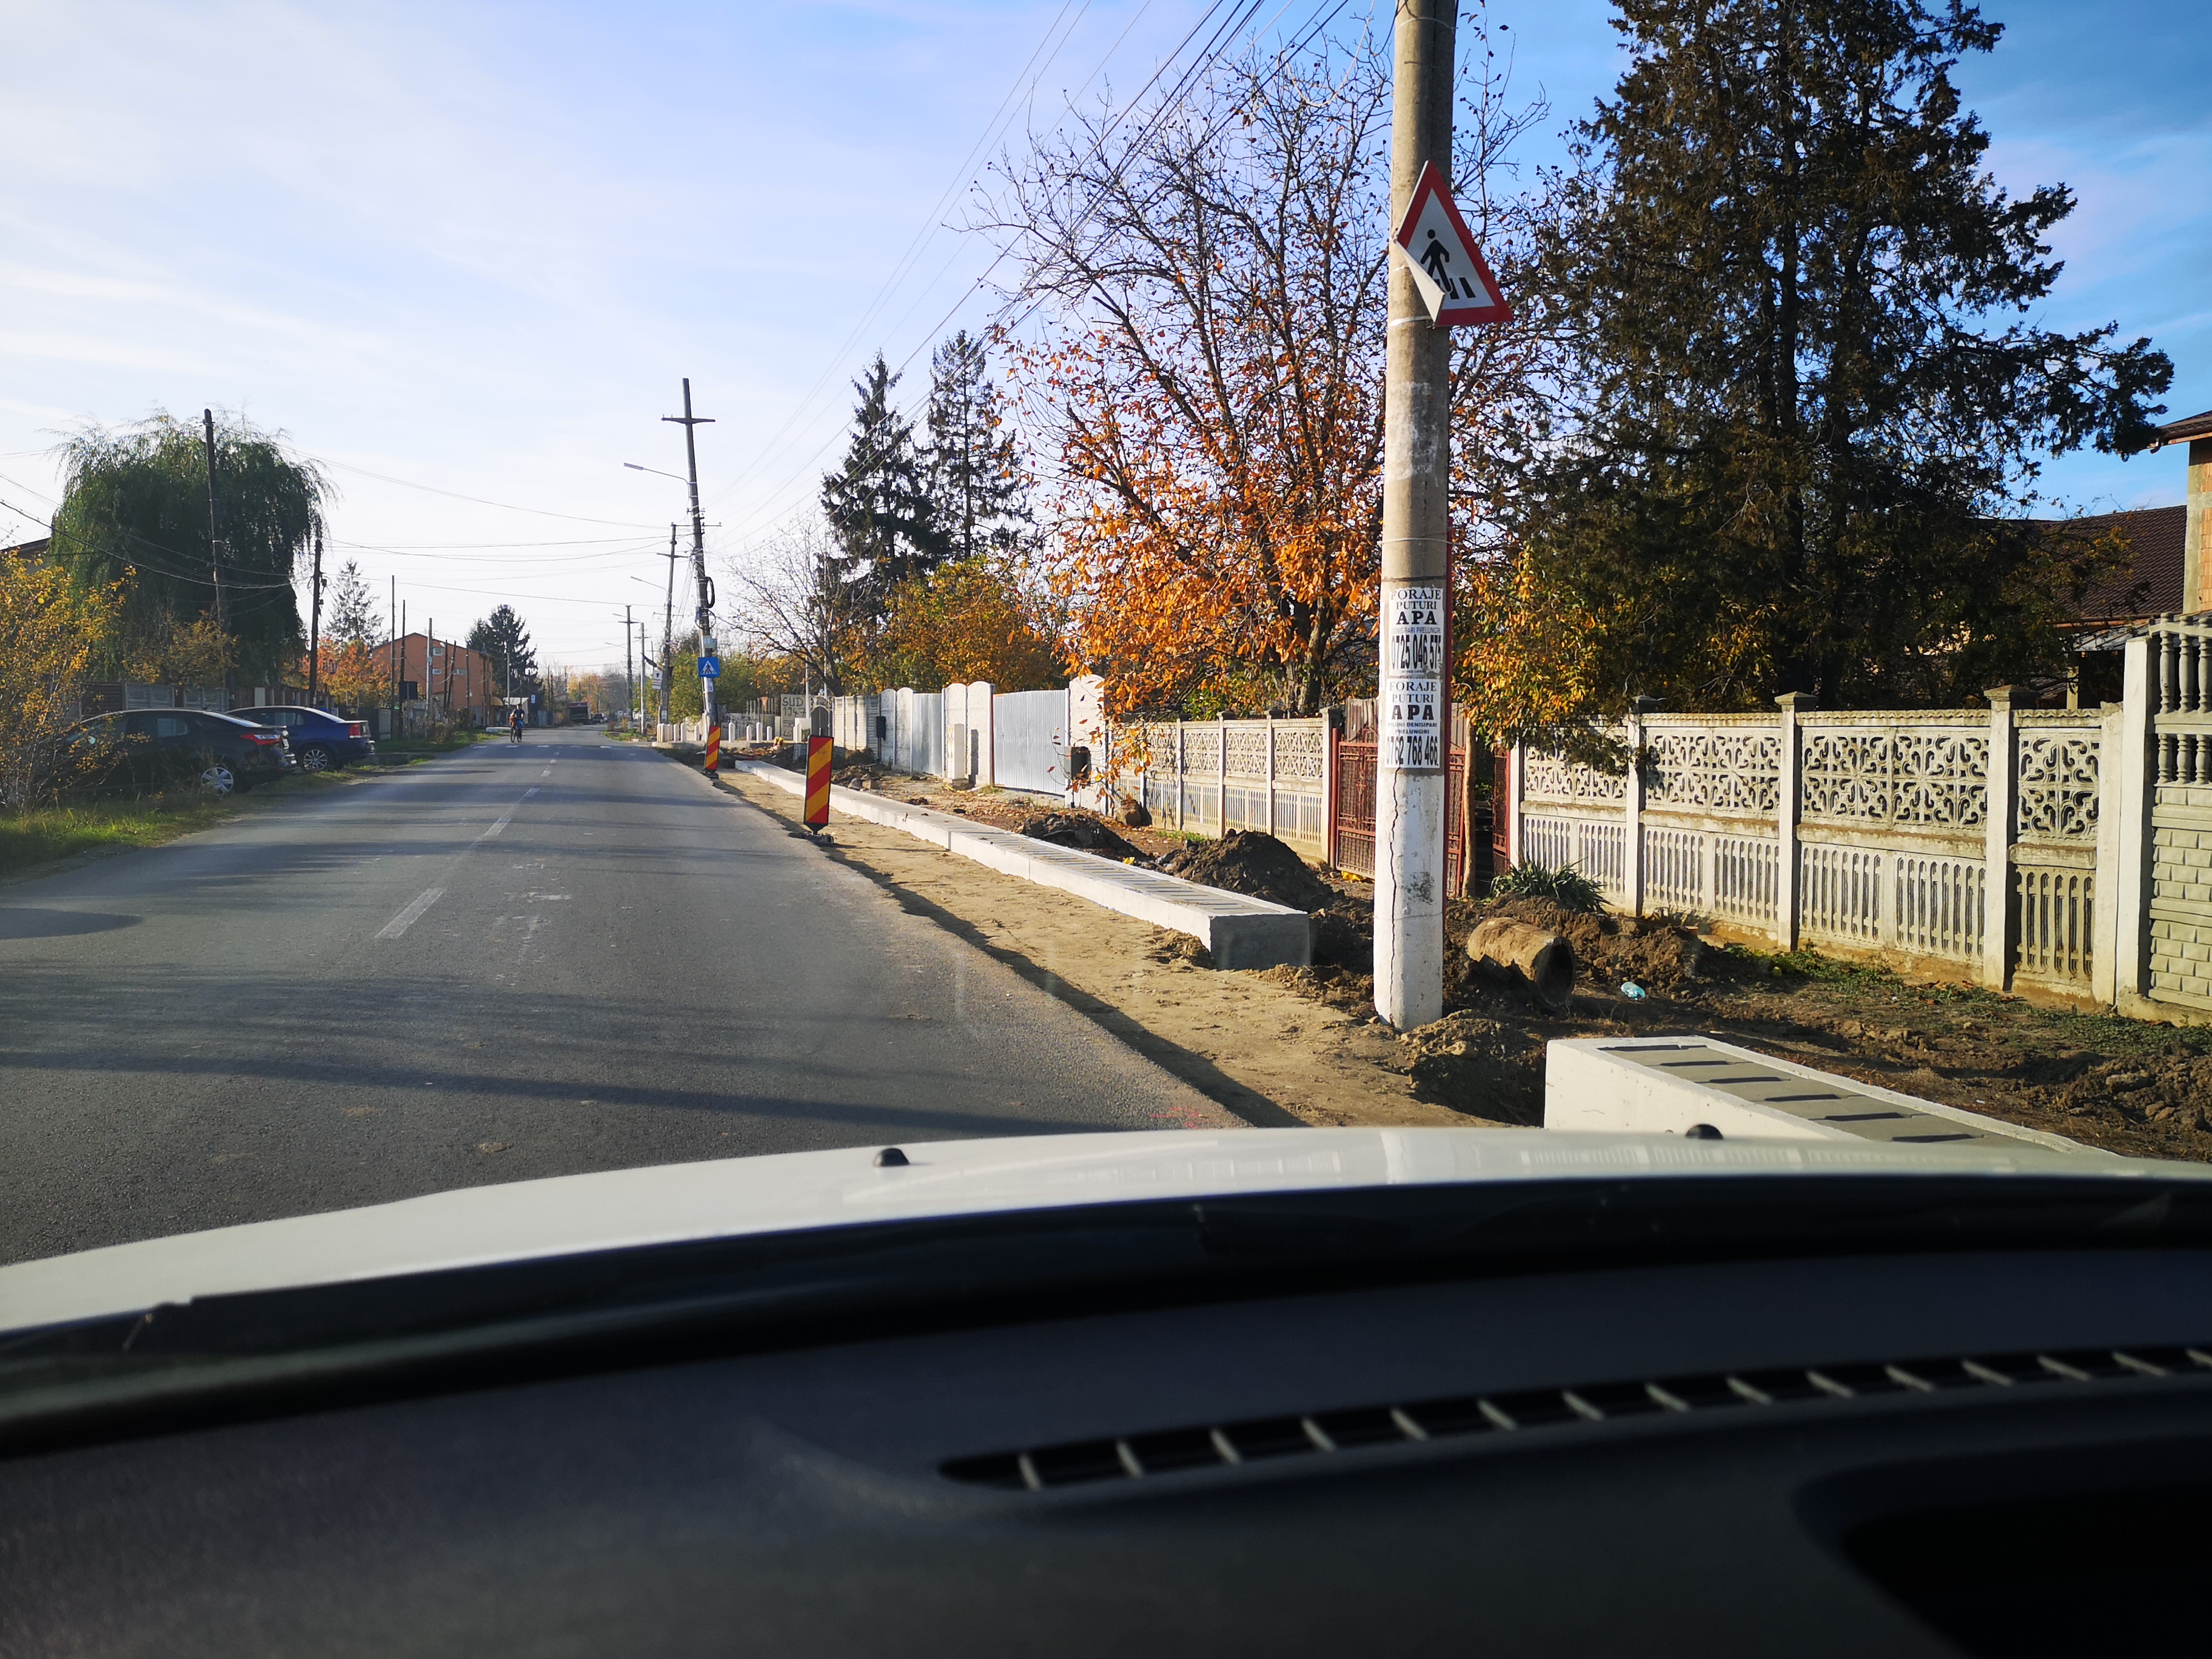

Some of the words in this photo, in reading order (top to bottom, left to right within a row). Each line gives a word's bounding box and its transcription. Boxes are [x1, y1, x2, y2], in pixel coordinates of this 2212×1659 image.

[1396, 601, 1437, 609] PUTURI
[1396, 611, 1437, 625] APA
[1392, 634, 1410, 669] 0725
[1413, 634, 1428, 669] 046
[1390, 682, 1437, 691] FORAJE
[782, 697, 803, 706] SUD
[1392, 694, 1433, 703] PUTURI
[1392, 705, 1434, 720] APA
[1386, 736, 1404, 765] 0762
[1407, 735, 1423, 765] 768
